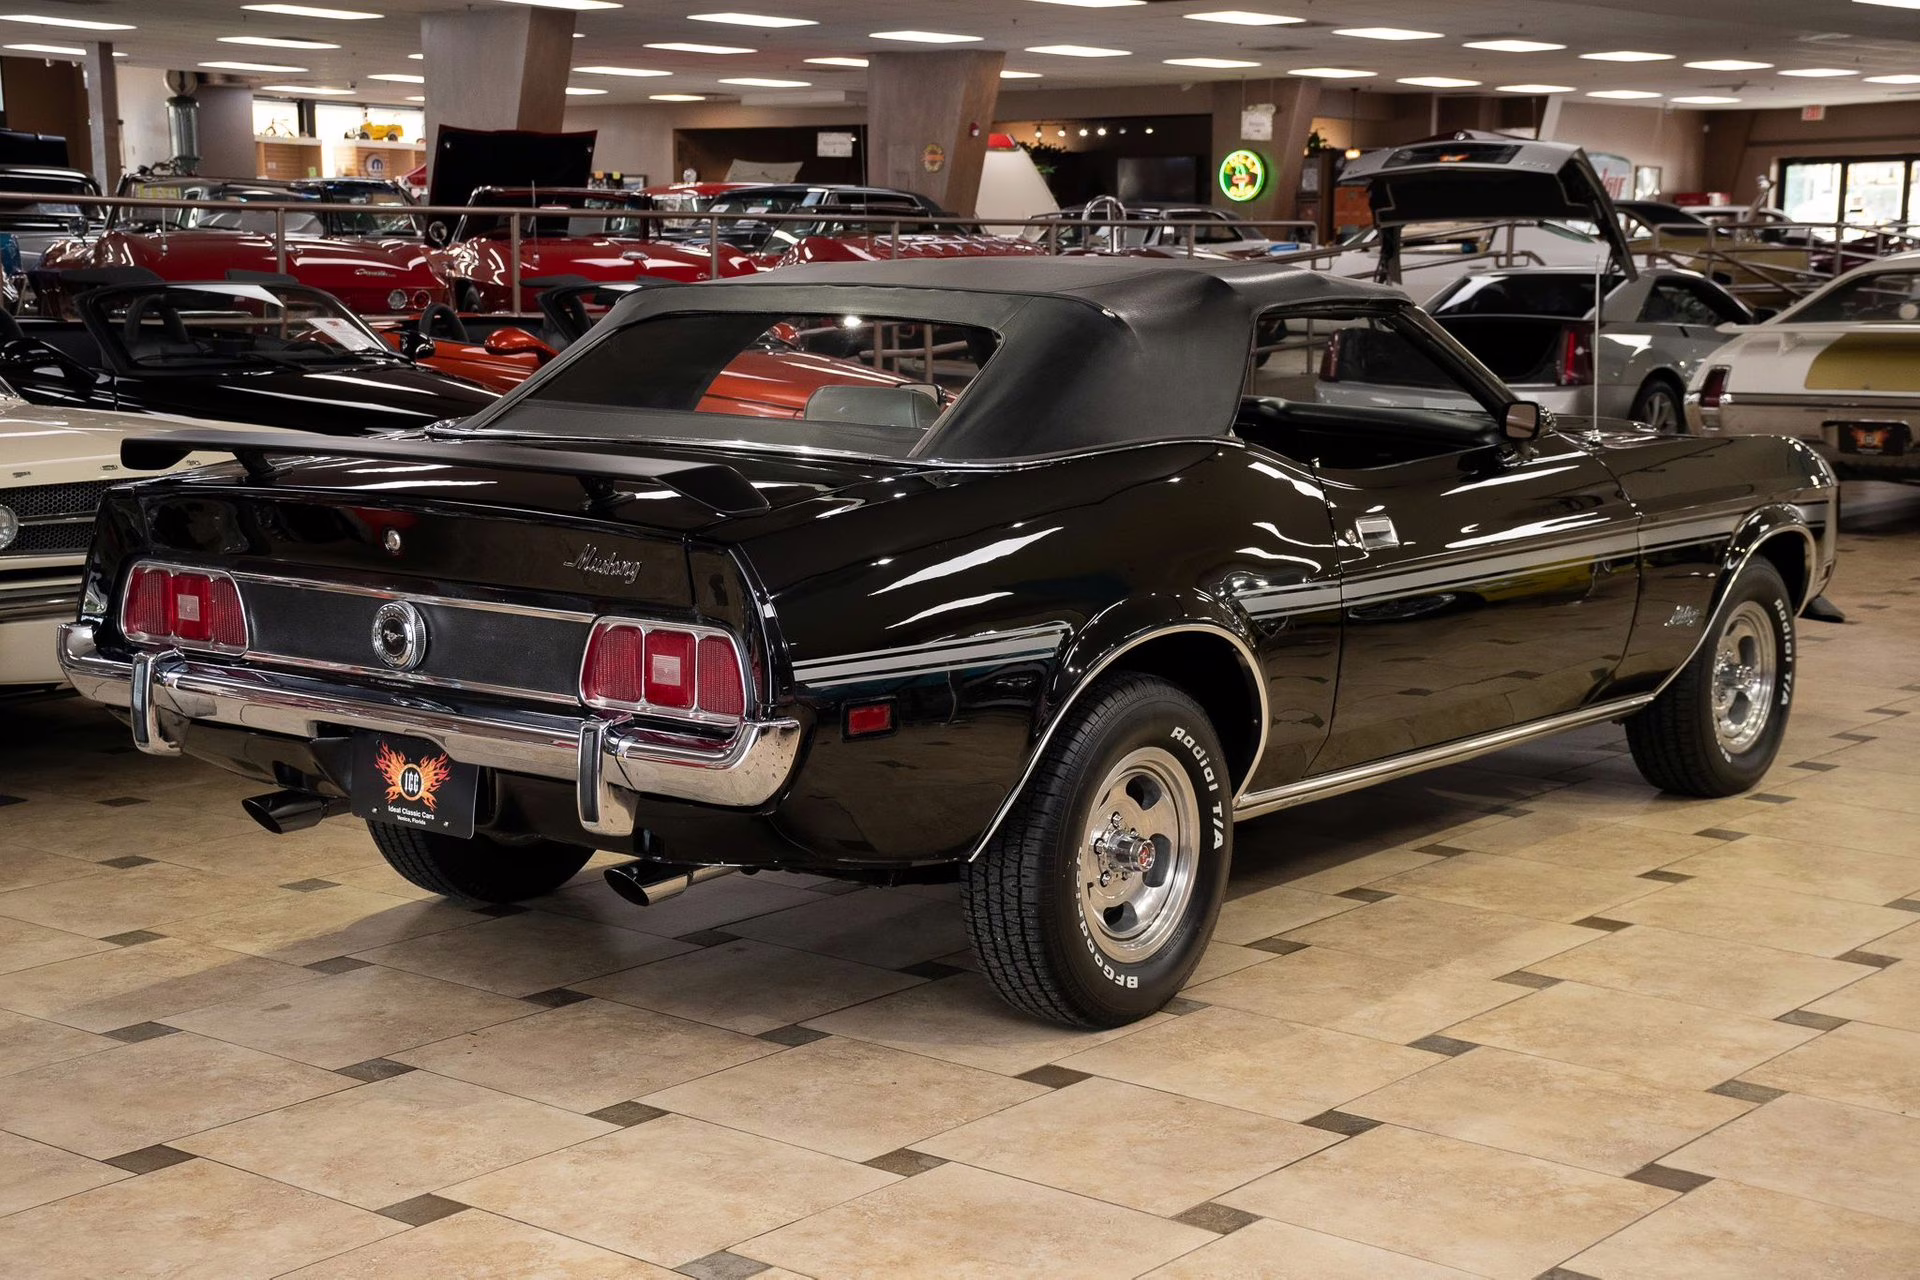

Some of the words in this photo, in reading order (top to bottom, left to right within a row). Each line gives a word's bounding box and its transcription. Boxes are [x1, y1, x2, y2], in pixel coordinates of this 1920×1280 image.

[563, 543, 642, 585] Mustang
[1774, 598, 1793, 662] Radial
[1170, 726, 1219, 792] Radial
[1211, 801, 1225, 850] T/A
[387, 805, 401, 814] Ideal
[401, 807, 421, 818] Classic
[421, 811, 435, 820] Cars
[411, 817, 426, 826] Florida
